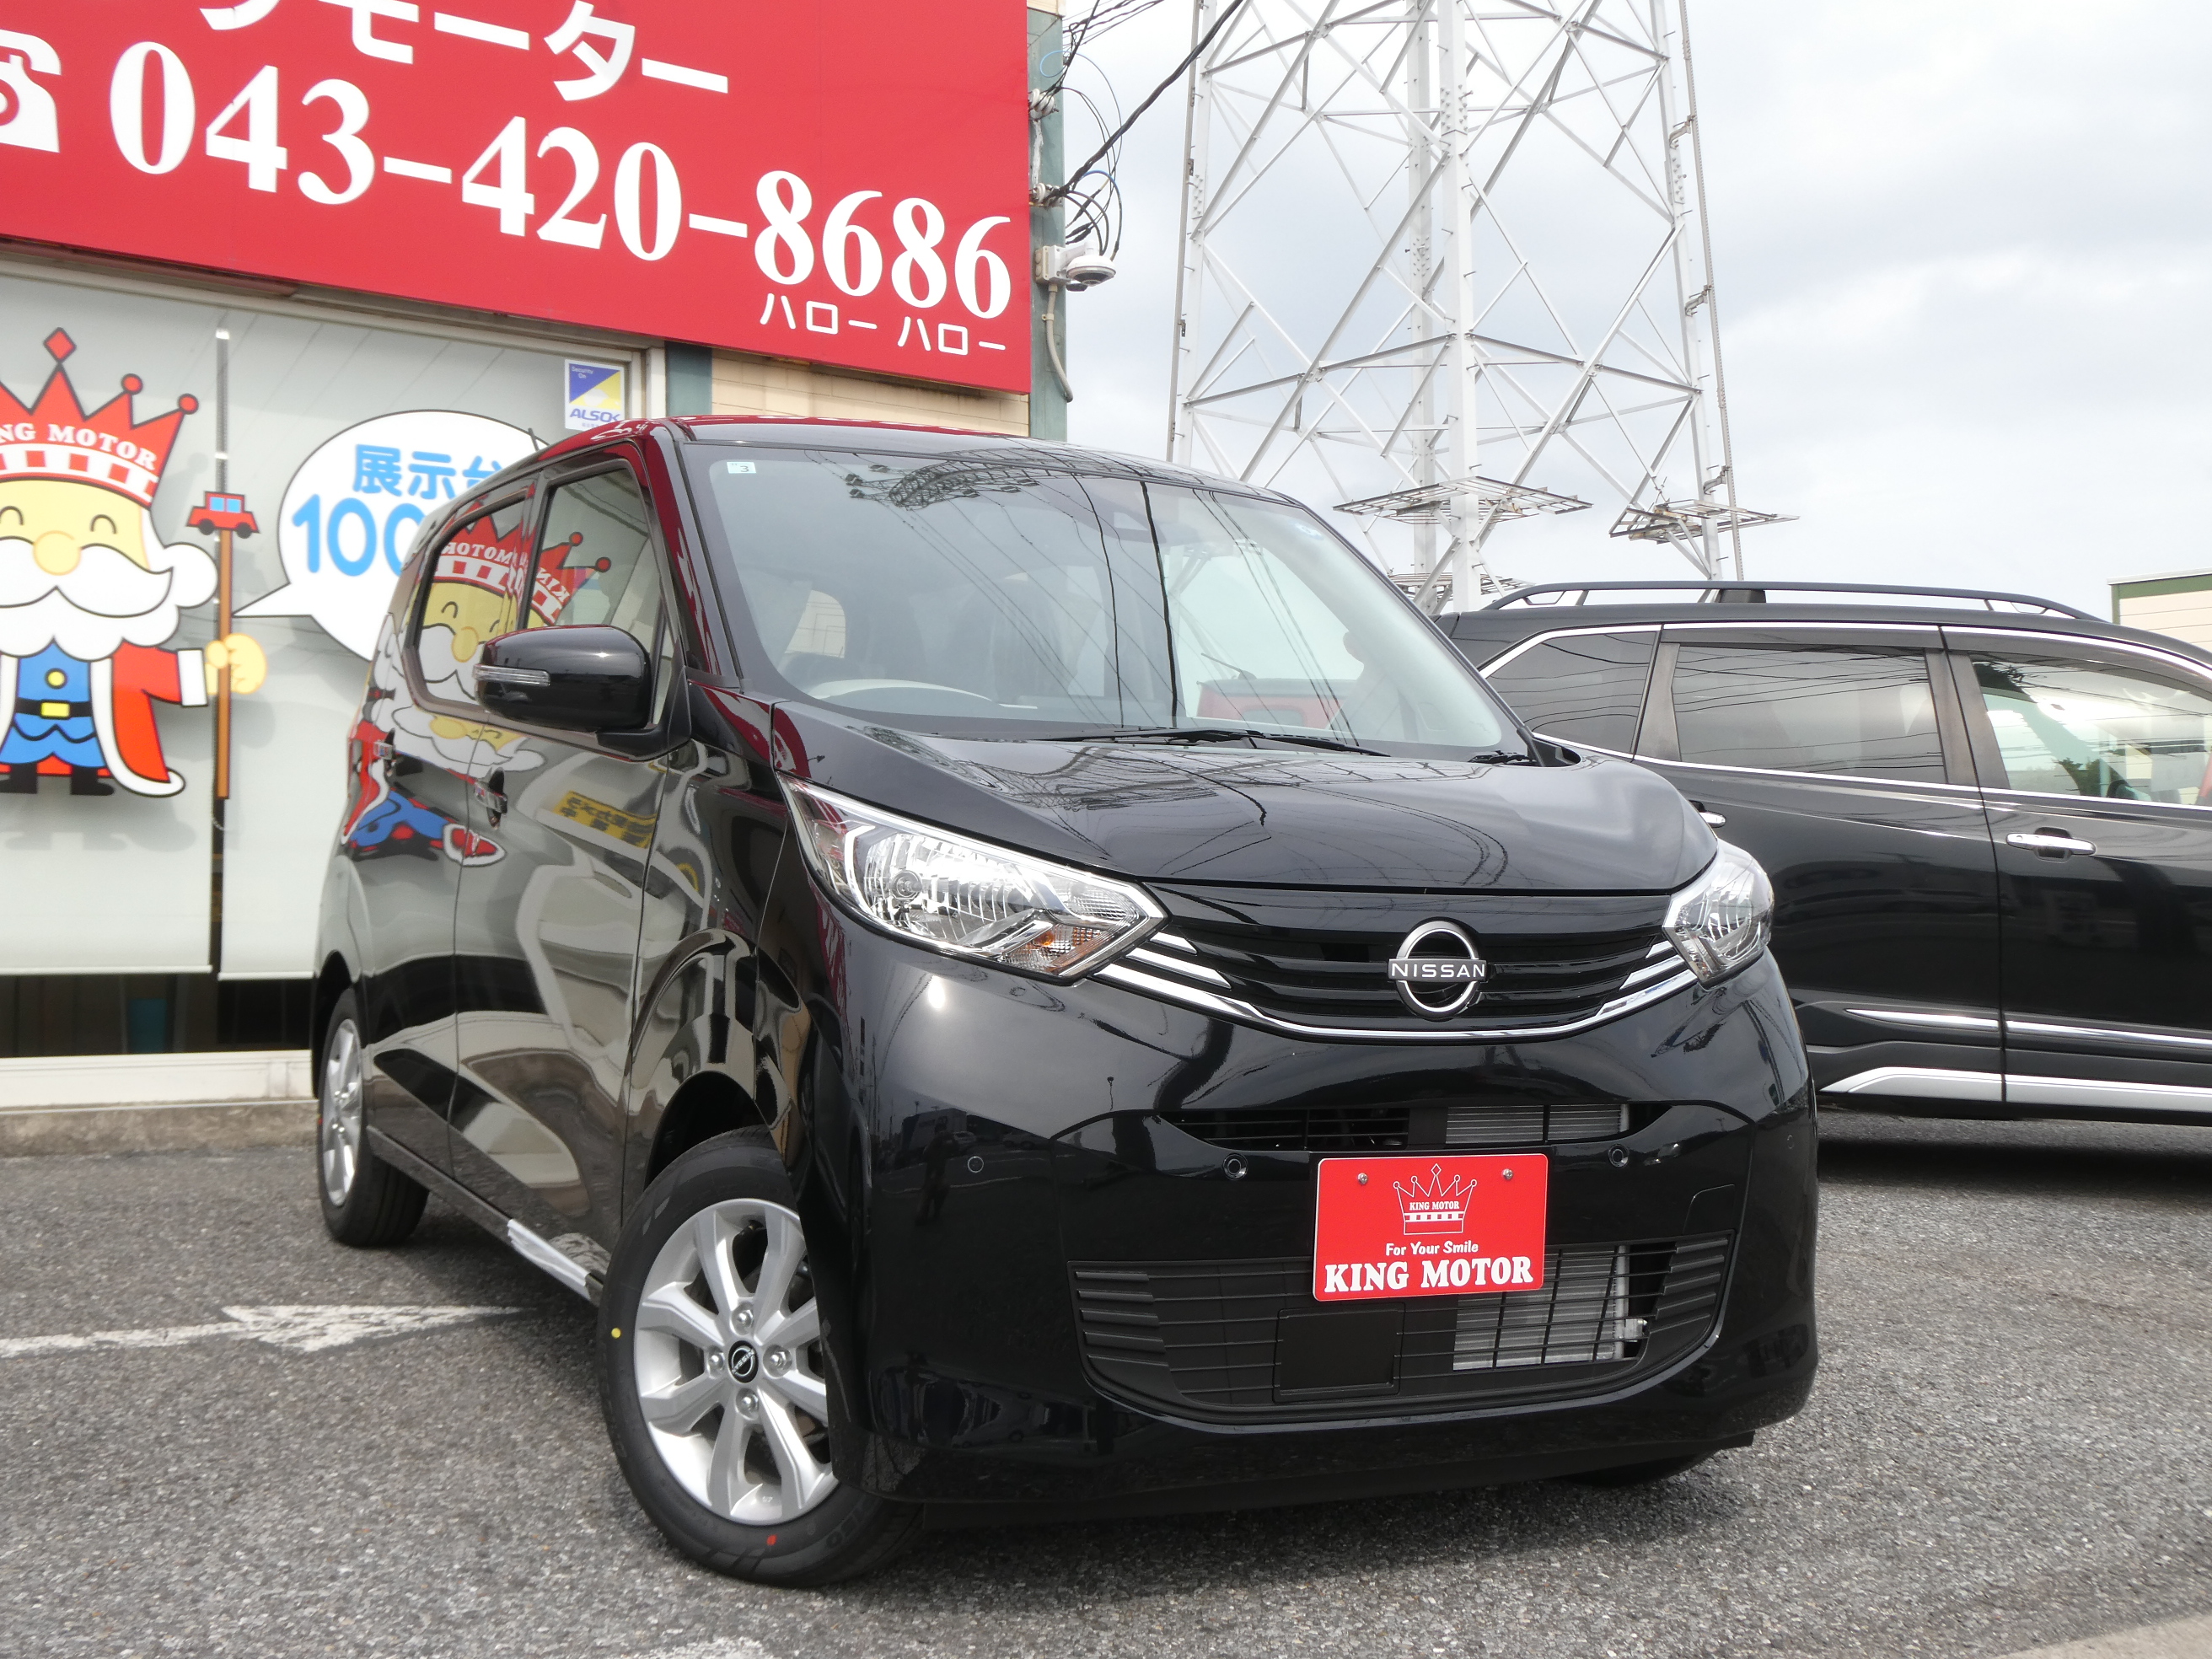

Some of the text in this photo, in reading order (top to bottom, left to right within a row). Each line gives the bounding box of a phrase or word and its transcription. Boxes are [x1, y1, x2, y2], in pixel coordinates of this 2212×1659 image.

[110, 40, 1012, 319] 043-420-8686
[760, 292, 1007, 356] ハロー ハロー
[570, 408, 620, 422] ALSOK
[47, 423, 158, 471] MOTOR
[1391, 963, 1485, 978] NISSAN
[1409, 1200, 1460, 1211] KING MOTOR
[1385, 1240, 1479, 1257] For Your Smile
[1323, 1256, 1534, 1293] KING MOTOR
